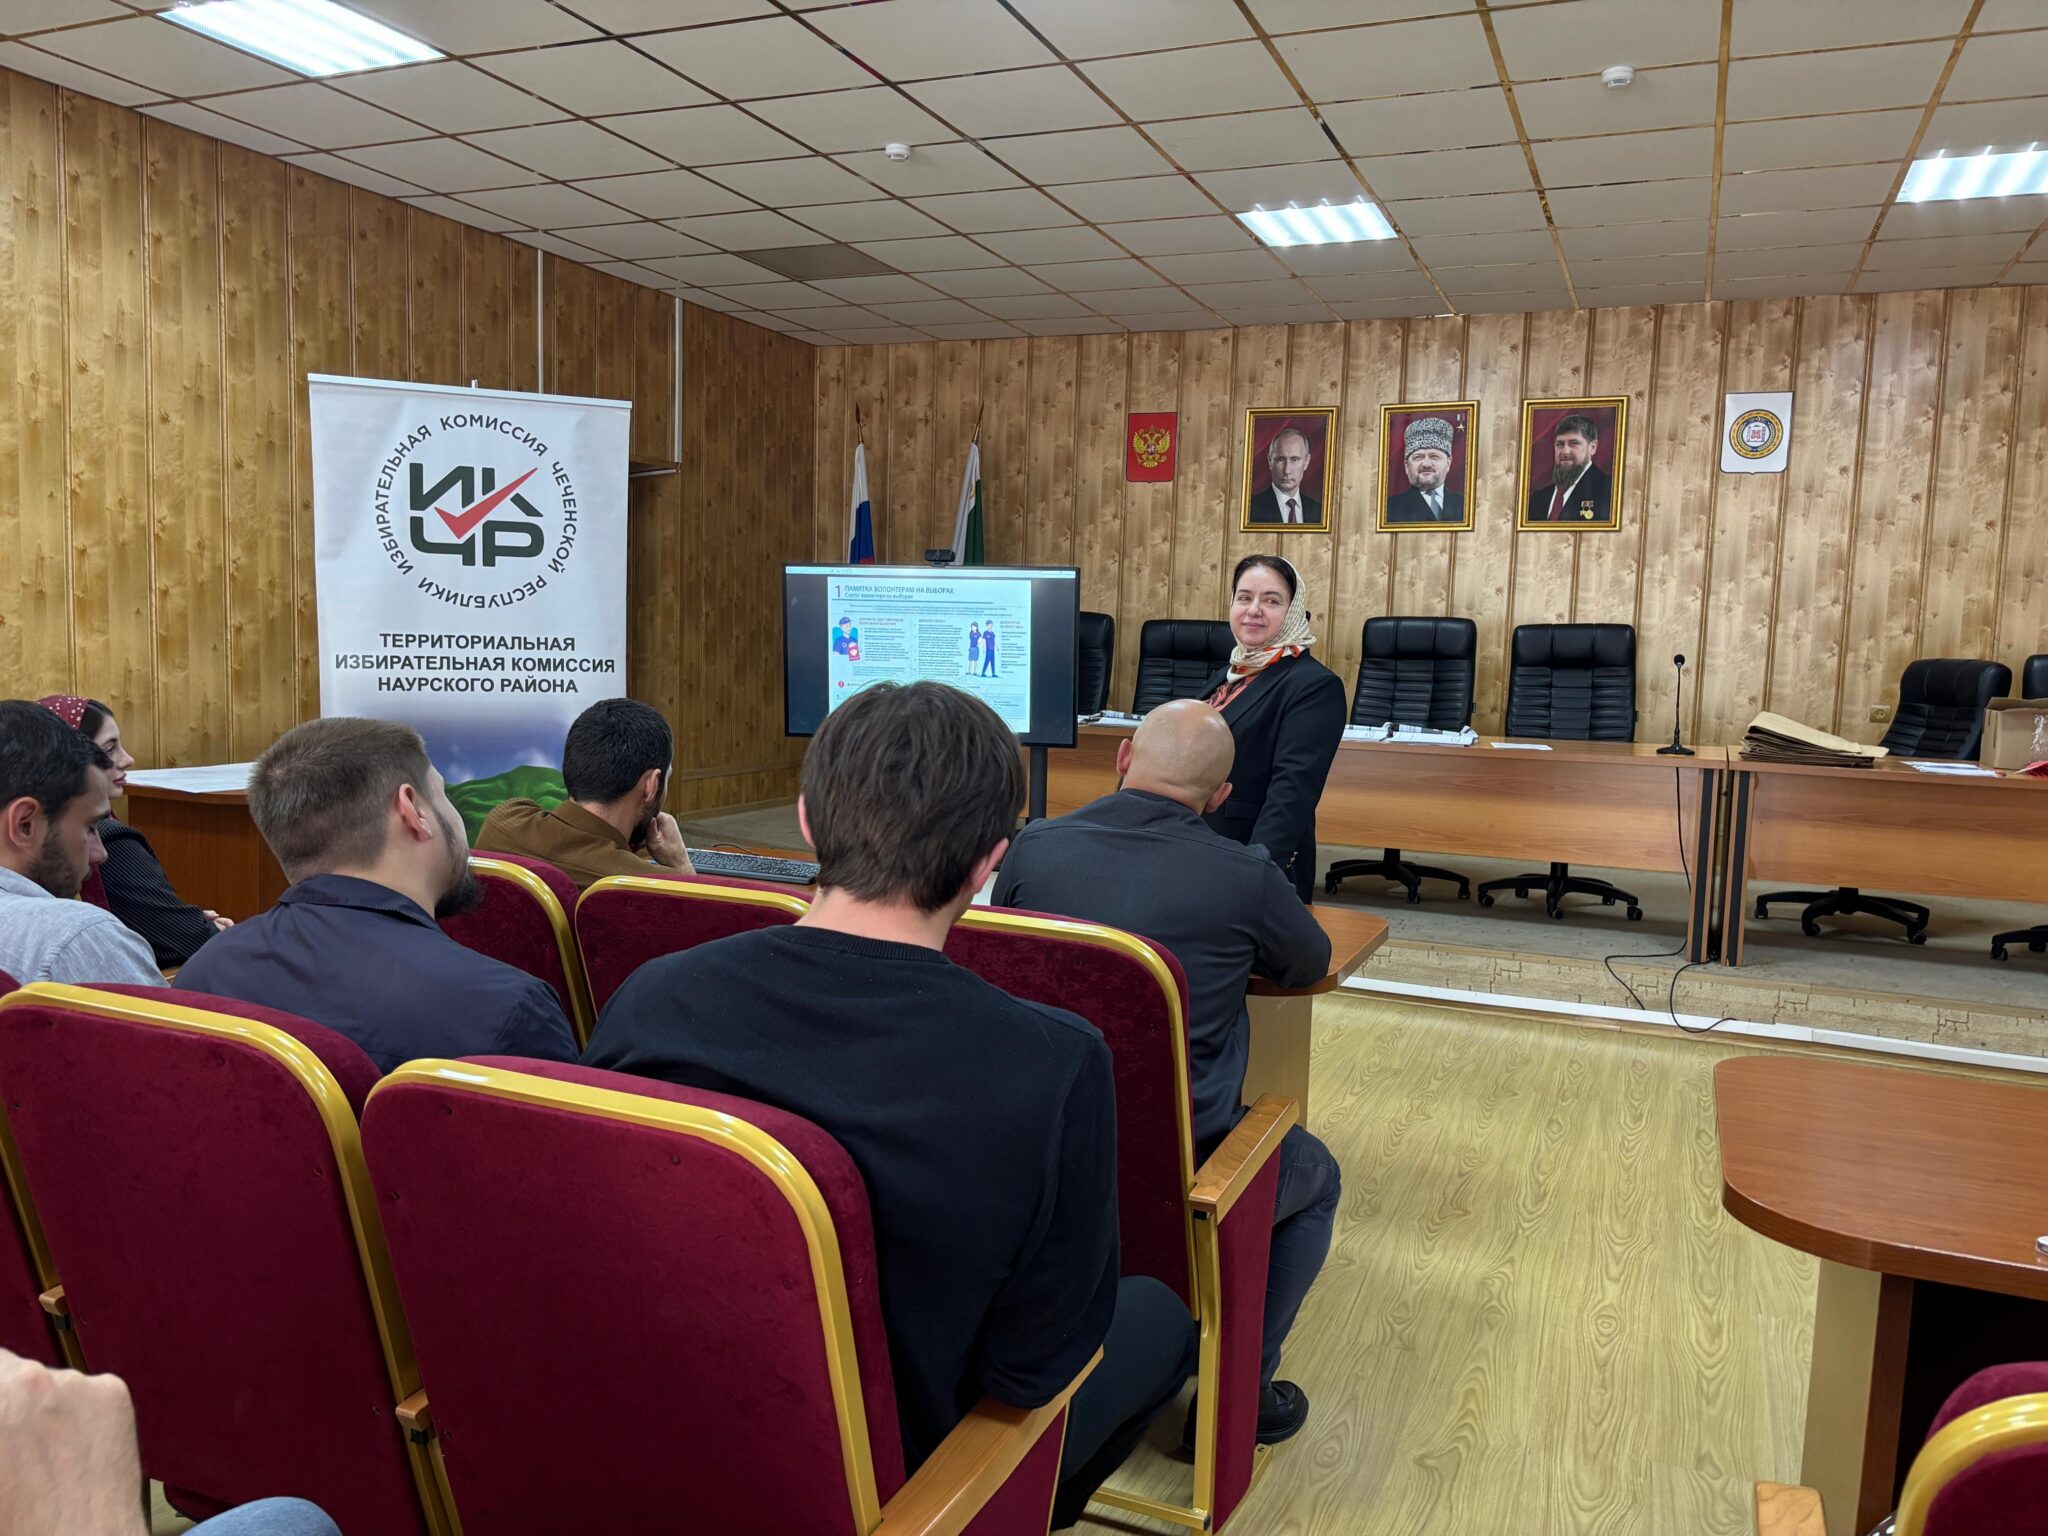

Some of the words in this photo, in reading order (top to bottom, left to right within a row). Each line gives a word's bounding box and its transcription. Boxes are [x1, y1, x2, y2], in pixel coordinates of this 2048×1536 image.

[440, 414, 548, 457] КОМИССИЯ
[375, 424, 432, 575] ИЗБИРАТЕЛЬНАЯ
[548, 461, 577, 574] ЧЕЧЕНСКОЙ
[417, 575, 547, 608] РЕСПУБЛИКИ
[379, 633, 576, 651] ТЕРРИТОРИАЛЬНАЯ
[335, 654, 505, 672] ИЗБИРАТЕЛЬНАЯ
[511, 657, 615, 673] КОМИССИЯ
[378, 677, 495, 692] НАУРСКОГО
[500, 675, 579, 693] РАЙОНА
